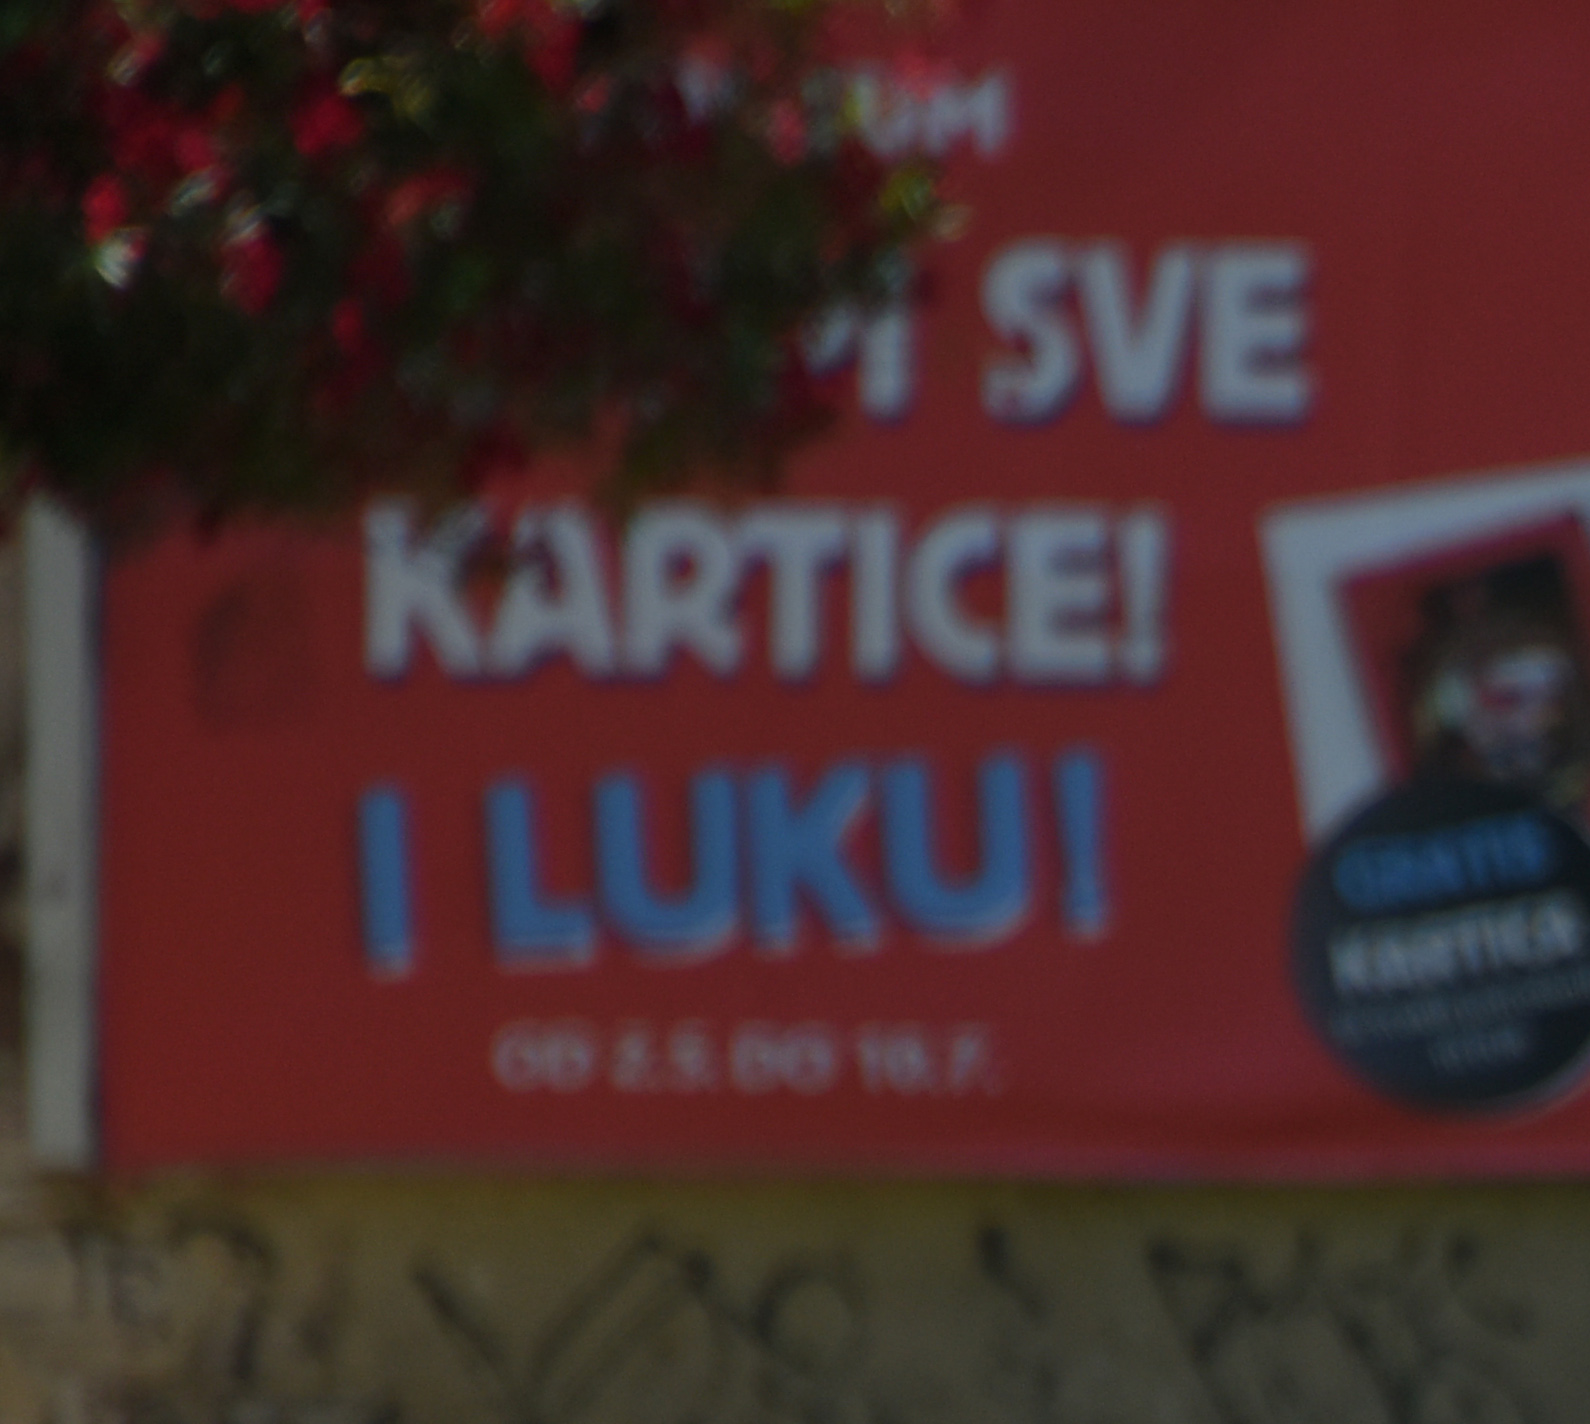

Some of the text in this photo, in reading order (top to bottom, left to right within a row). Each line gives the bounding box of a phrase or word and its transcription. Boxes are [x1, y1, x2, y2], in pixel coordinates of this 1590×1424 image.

[982, 240, 1308, 422] SVE
[364, 500, 1168, 682] KARTICE!
[358, 752, 1108, 978] I LUKU!
[731, 1020, 838, 1092] DO
